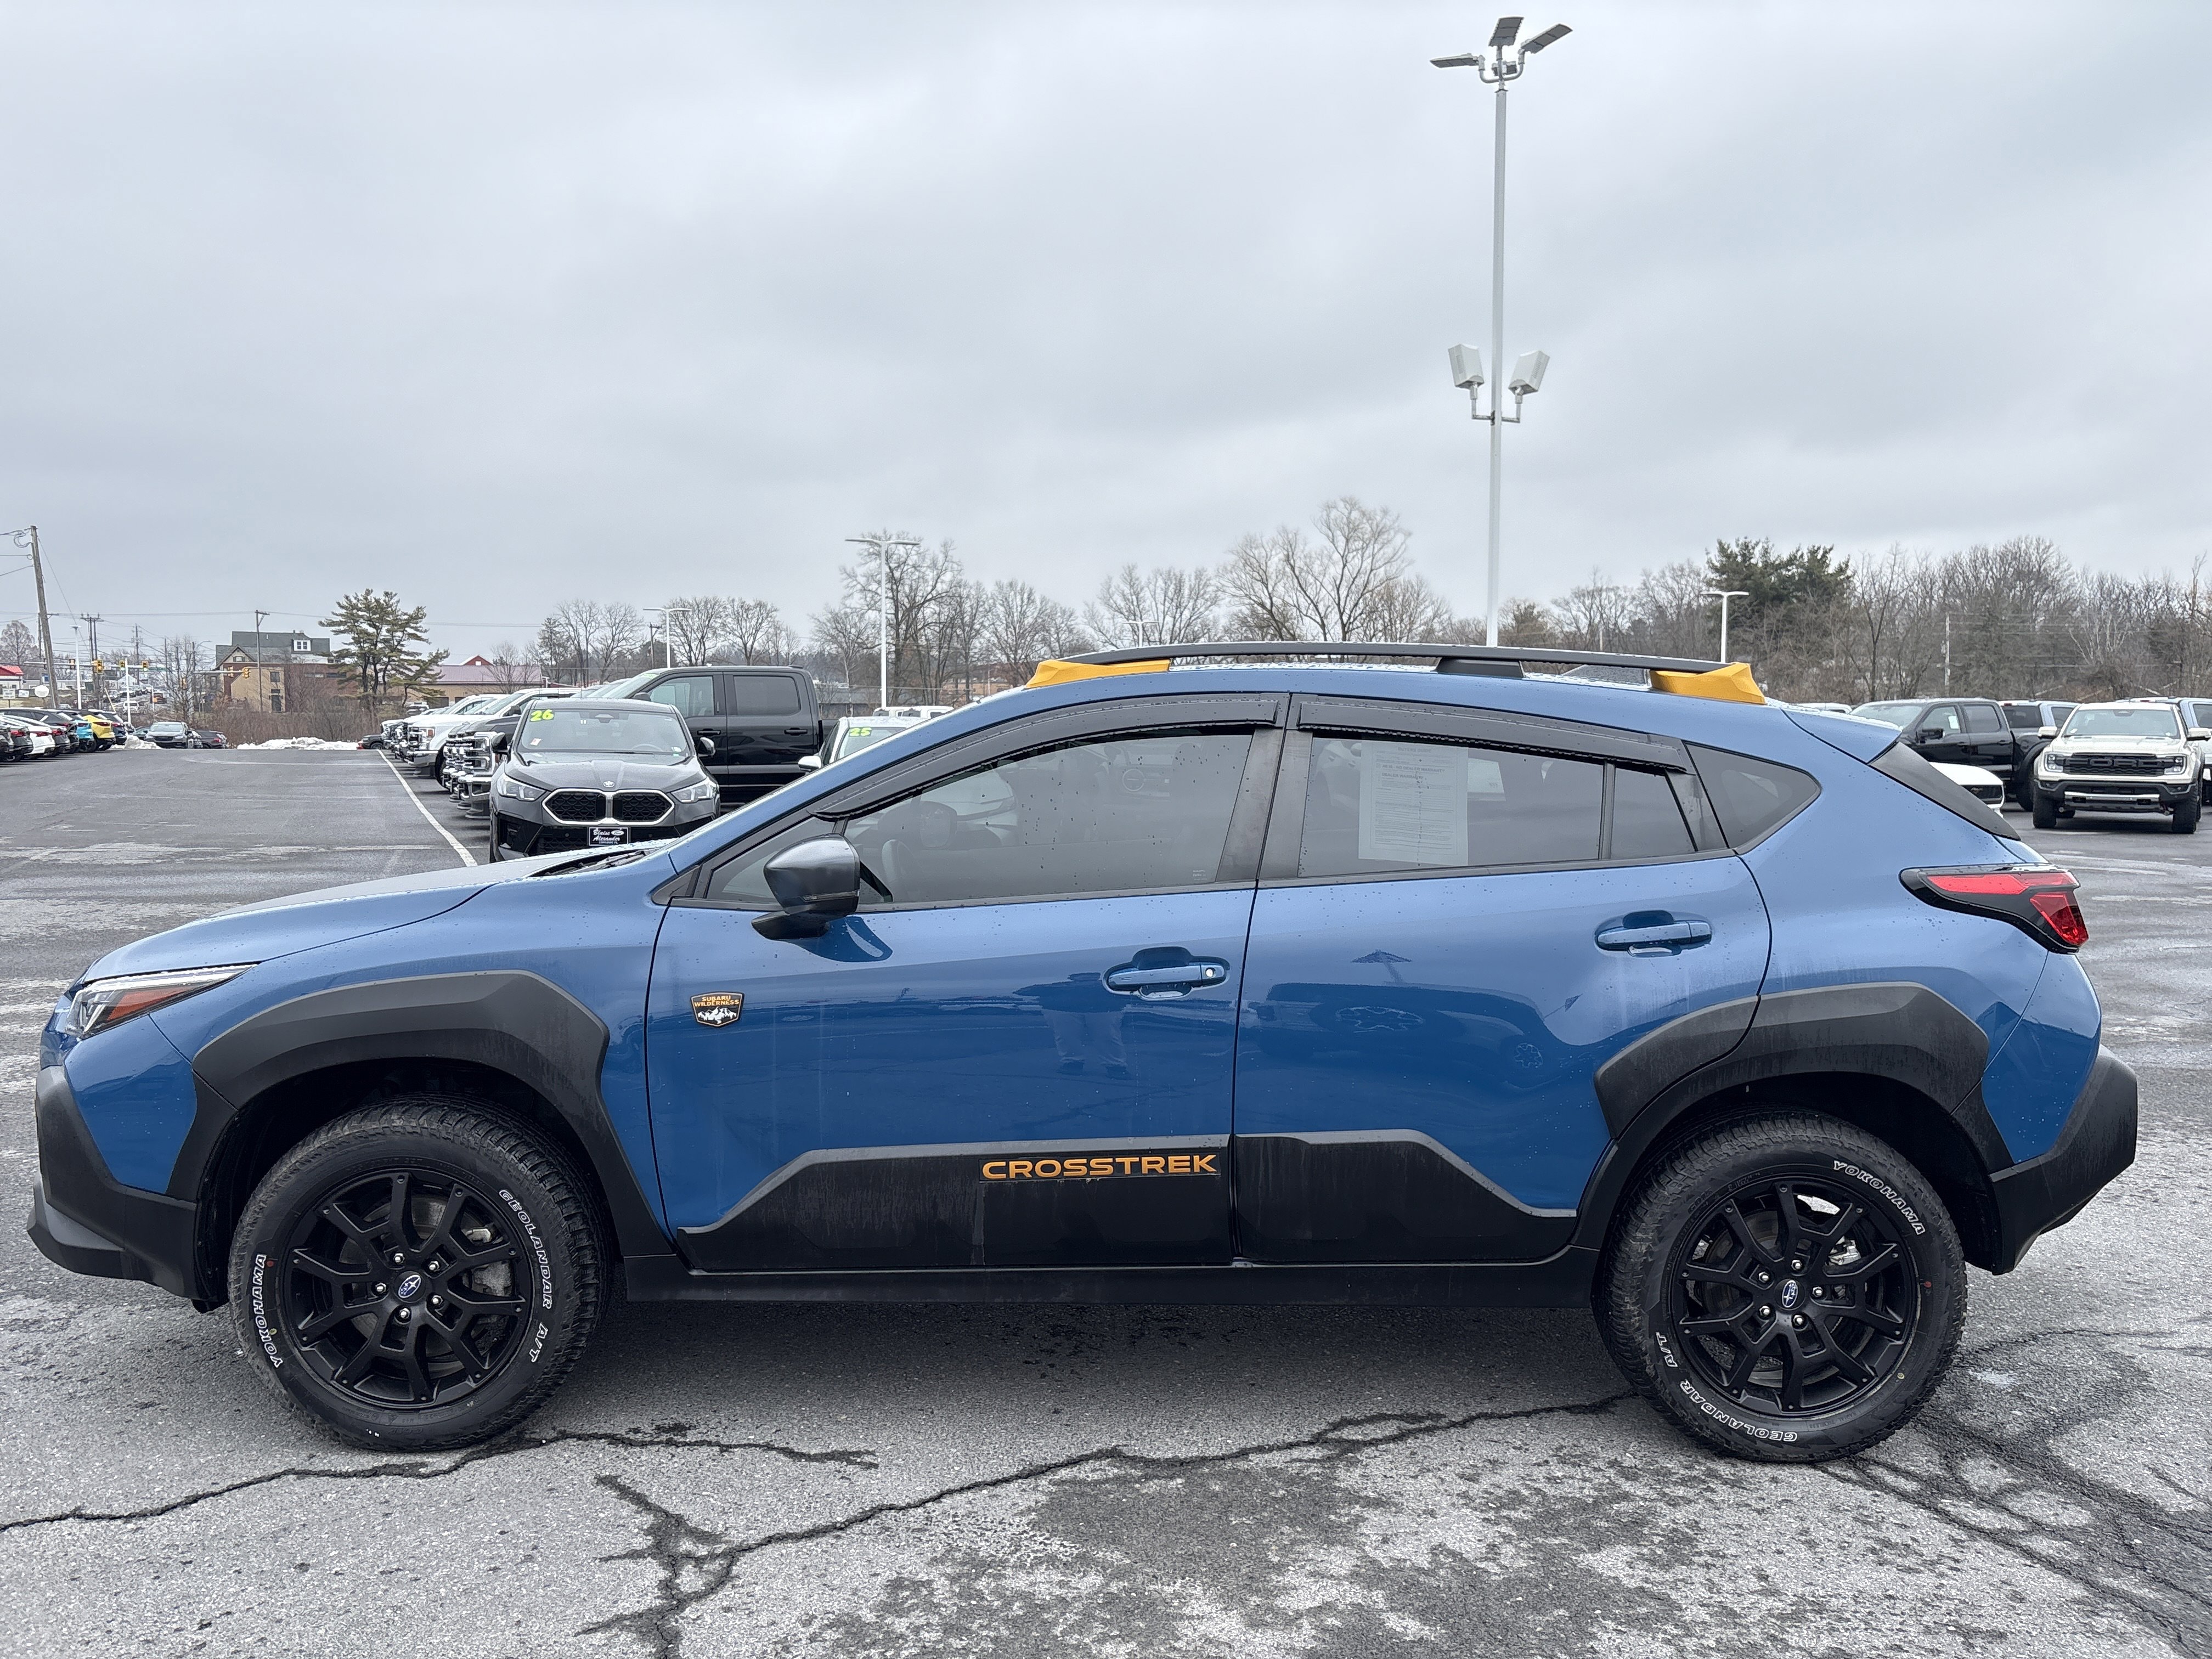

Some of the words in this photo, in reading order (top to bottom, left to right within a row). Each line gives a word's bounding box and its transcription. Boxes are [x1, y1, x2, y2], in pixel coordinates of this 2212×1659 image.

[529, 709, 554, 721] 26
[849, 727, 872, 737] 25
[2066, 758, 2163, 768] FORD
[982, 1154, 1217, 1179] CROSSTREK
[1833, 1160, 1926, 1235] YOKOHAMA
[499, 1189, 552, 1310] GEOLANDAR
[529, 1322, 549, 1363] A/T
[252, 1254, 283, 1368] YOKOHAMA
[1655, 1331, 1678, 1367] A/T
[1679, 1379, 1798, 1442] GEOLANDAR
